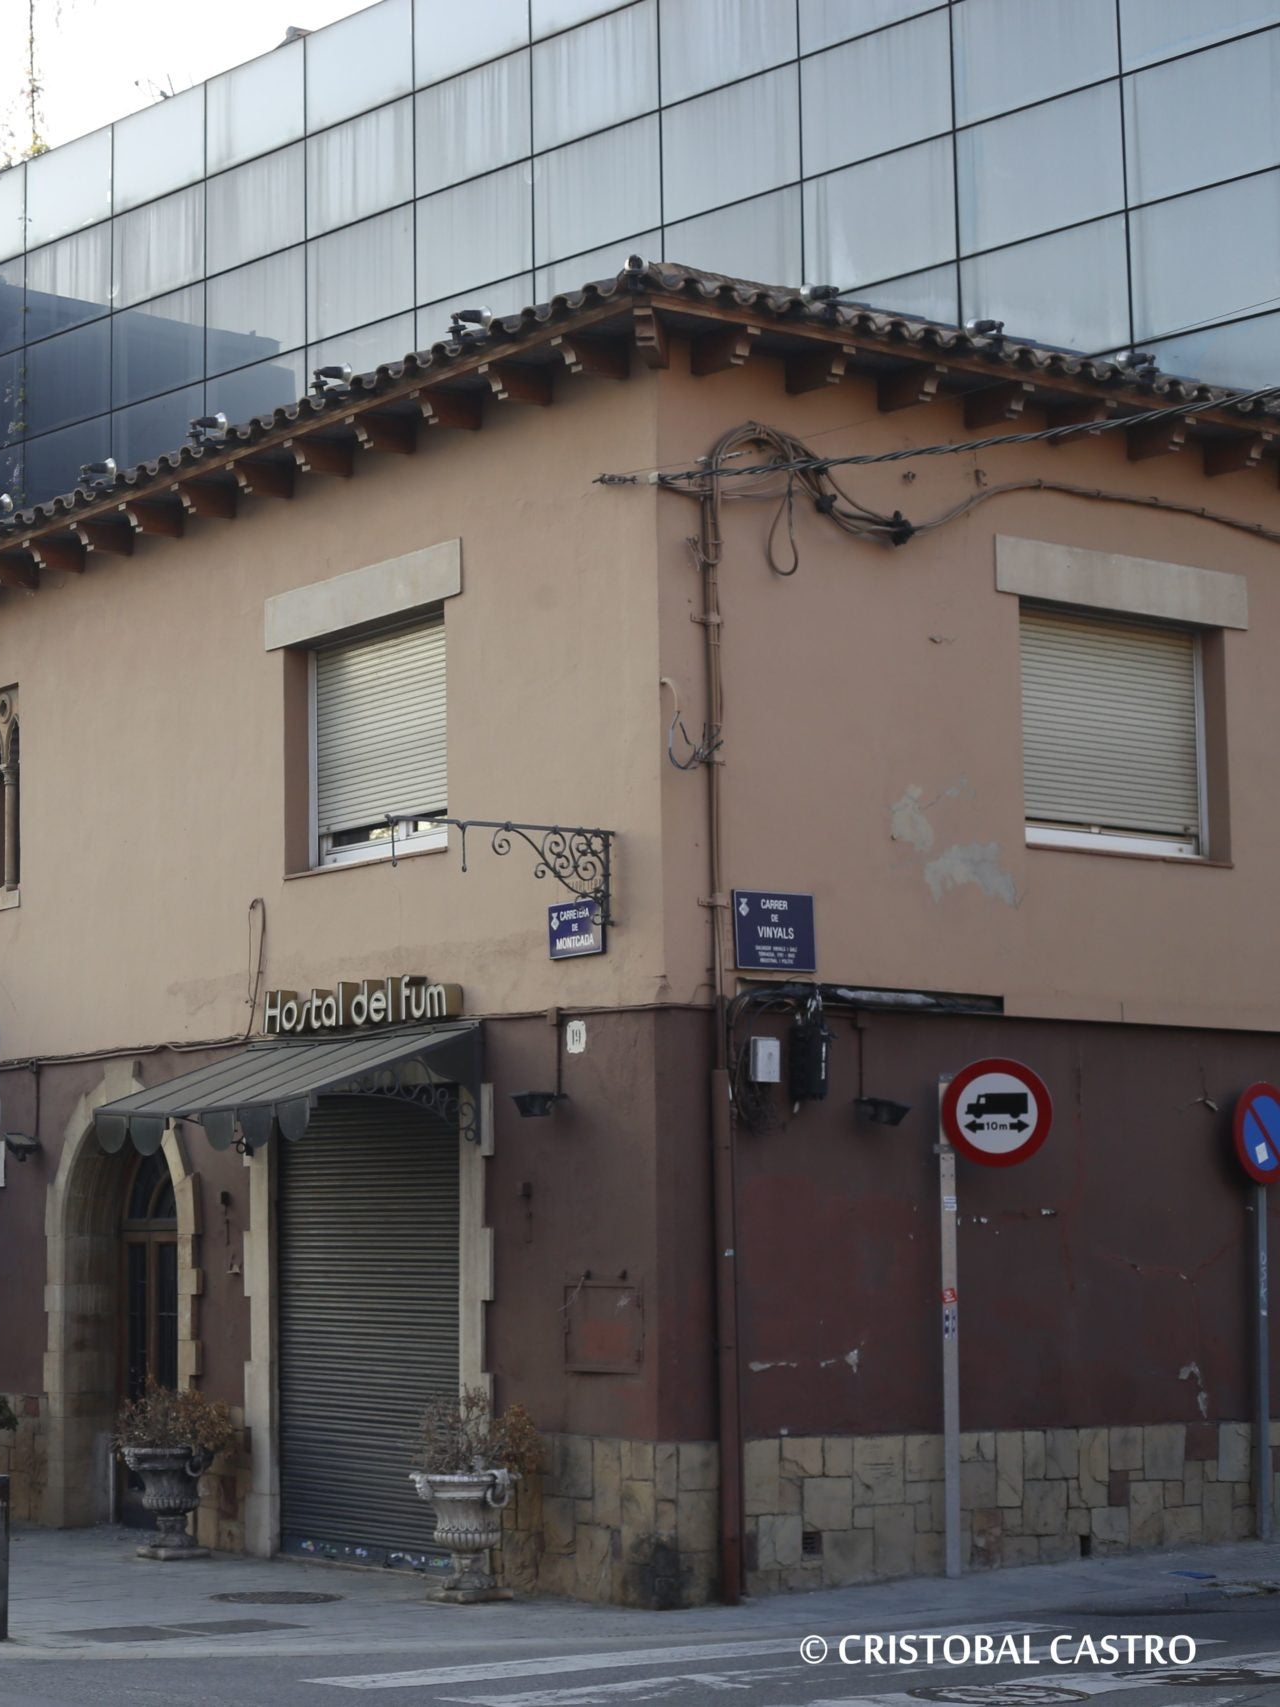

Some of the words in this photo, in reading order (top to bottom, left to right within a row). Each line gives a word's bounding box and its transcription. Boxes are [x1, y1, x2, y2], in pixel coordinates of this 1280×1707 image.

[760, 898, 788, 911] CARRER
[559, 907, 590, 922] CARRETERA
[770, 913, 779, 923] DE
[571, 922, 579, 932] DE
[757, 925, 795, 940] VINYALS
[556, 933, 595, 950] MONTCADA
[265, 981, 343, 1032] Hostal
[351, 977, 392, 1025] del
[400, 974, 449, 1021] fum
[572, 1028, 582, 1046] 19
